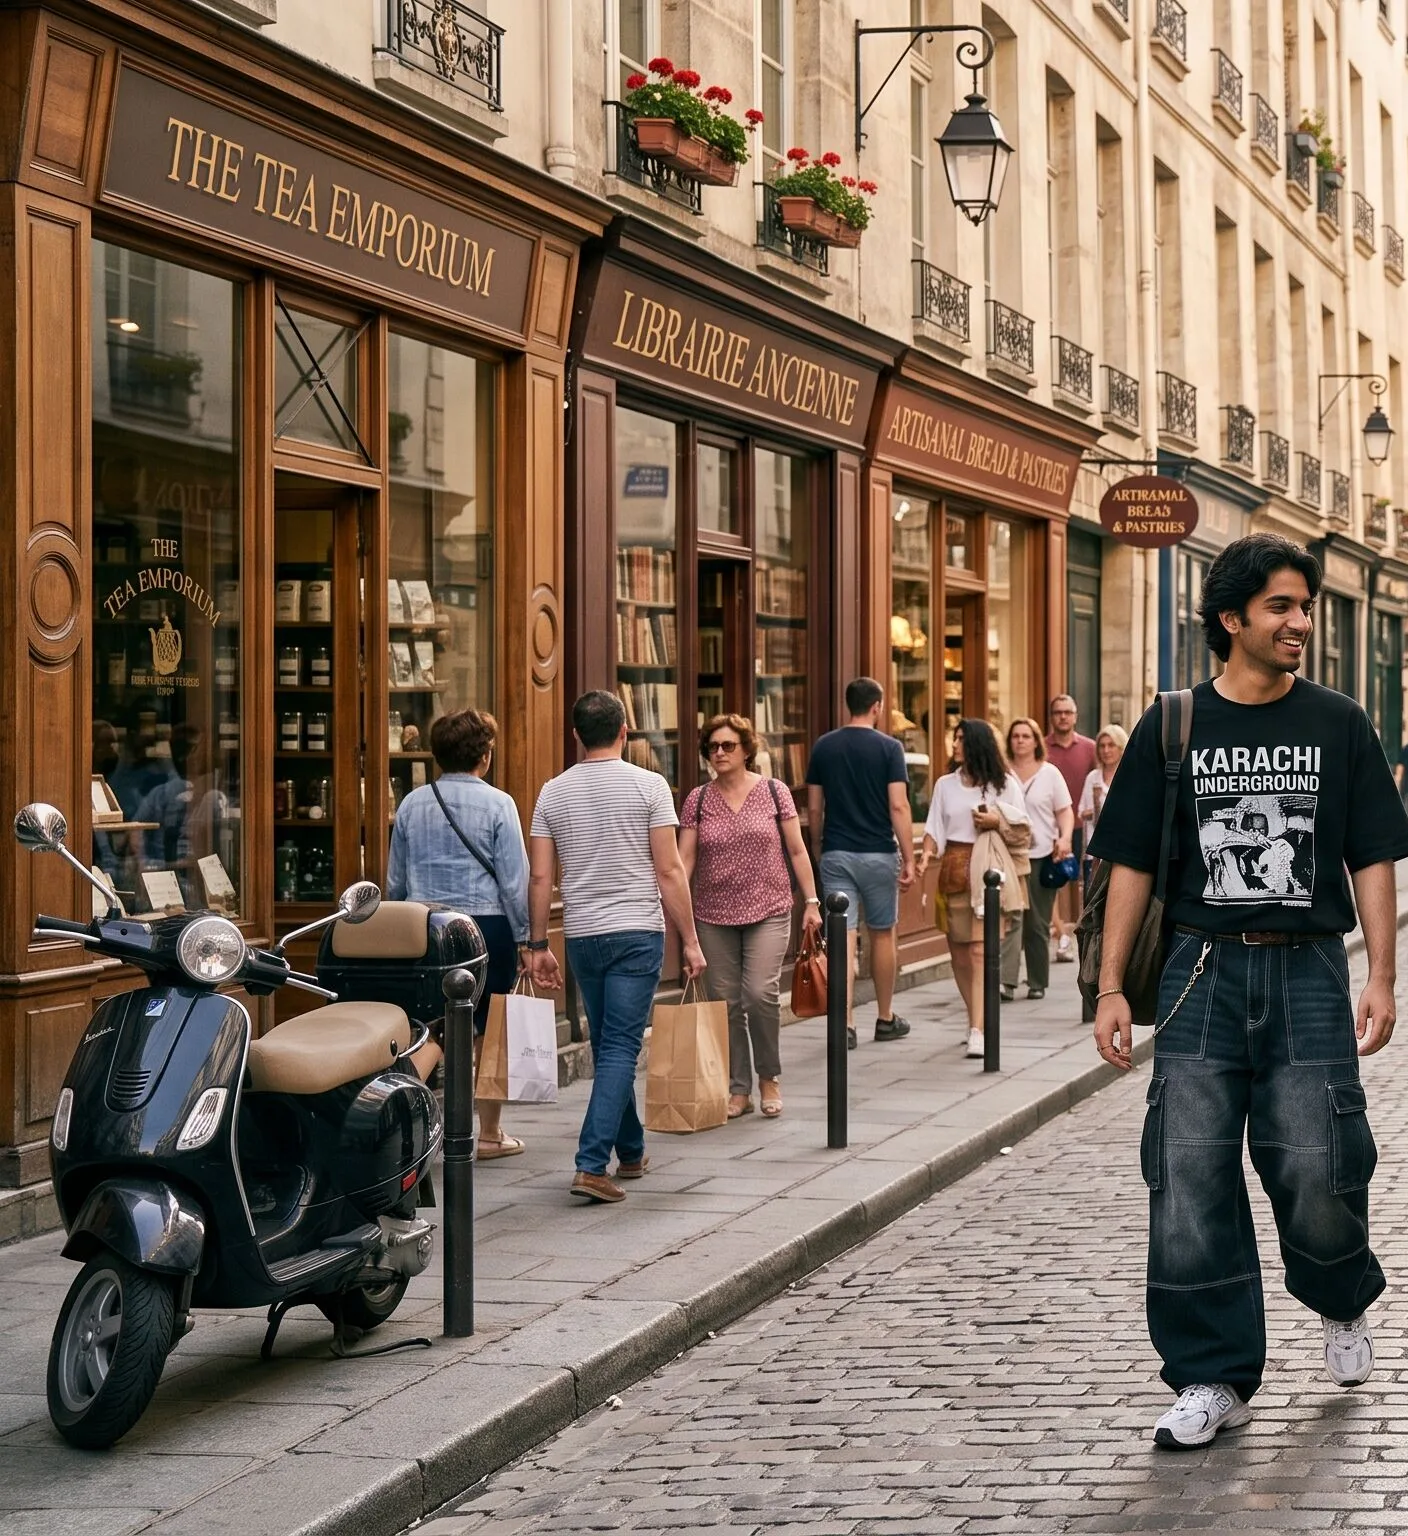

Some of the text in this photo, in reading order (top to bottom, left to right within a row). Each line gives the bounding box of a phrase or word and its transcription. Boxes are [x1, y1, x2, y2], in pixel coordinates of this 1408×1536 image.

[167, 117, 497, 298] THE TEA EMPORIUM
[612, 290, 860, 426] LIBRAIRIE ANCIENNE
[887, 405, 1070, 495] ARTISANAL BREAD & PASTRIES
[151, 538, 179, 559] THE
[1112, 521, 1186, 533] & PASTRIES
[103, 568, 221, 629] TEA EMPORIUM
[1191, 745, 1321, 776] KARACHI
[1193, 774, 1320, 795] UNDERGROUND
